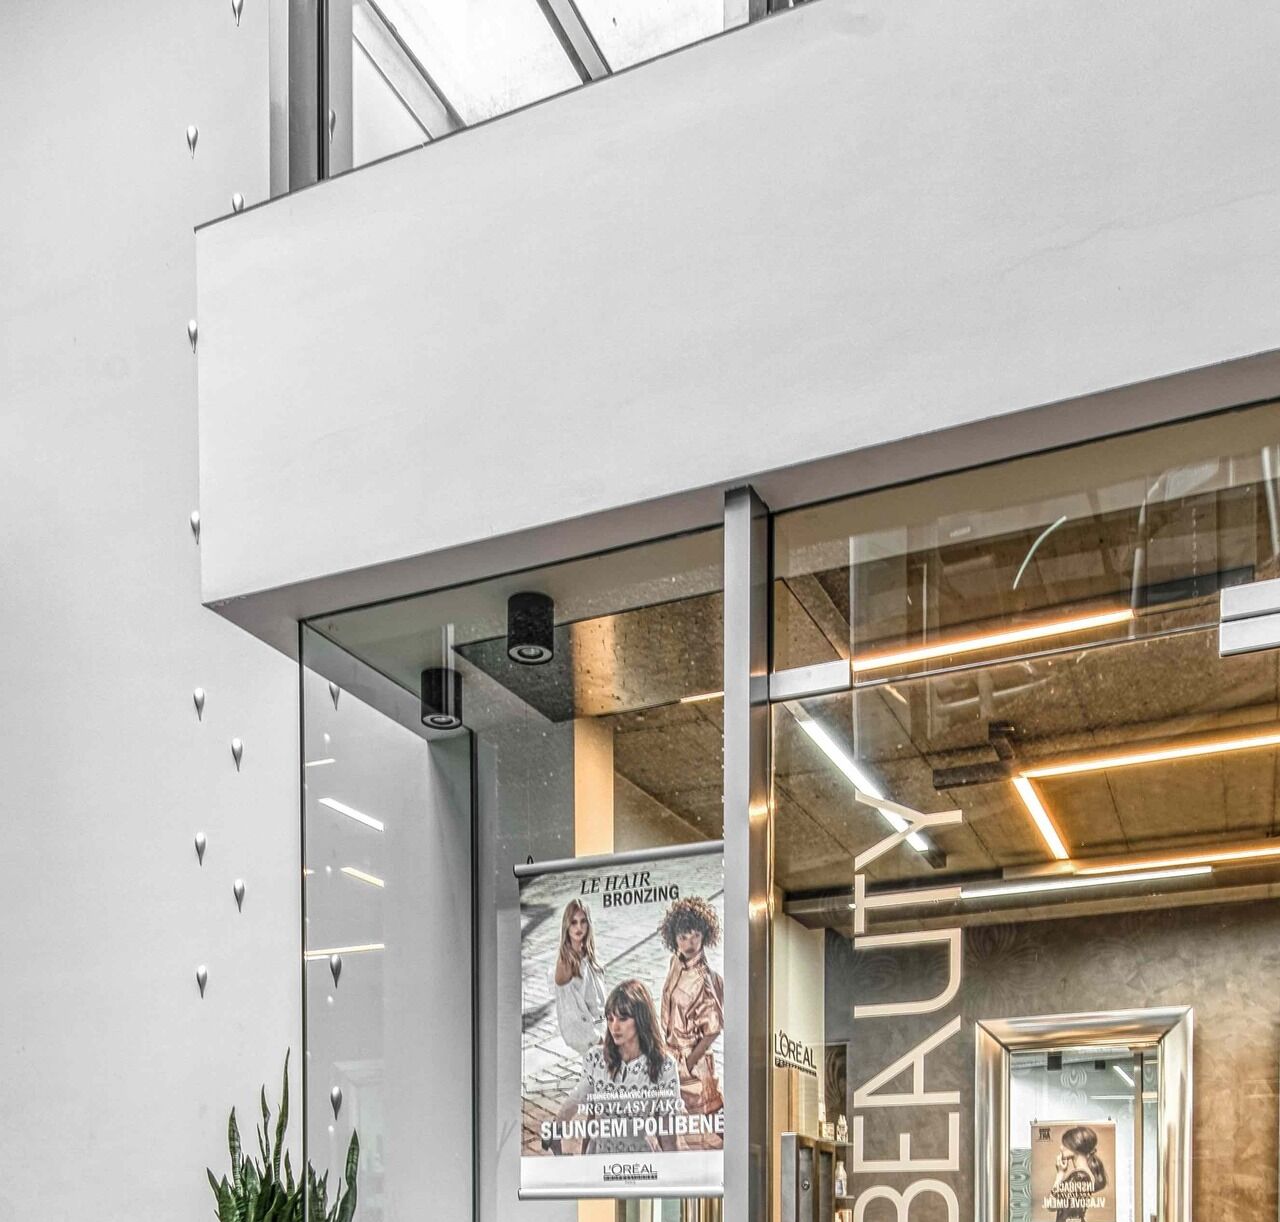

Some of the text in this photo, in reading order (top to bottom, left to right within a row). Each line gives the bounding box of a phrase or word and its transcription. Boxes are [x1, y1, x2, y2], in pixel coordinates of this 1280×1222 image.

[581, 870, 651, 896] LE HAIR
[603, 884, 679, 909] BRONZING
[774, 1028, 818, 1070] L'ORÉAL
[576, 1097, 686, 1116] PRO VLASY JAKO
[540, 1117, 628, 1141] SLUNCEM
[603, 1162, 658, 1177] L'ORÉAL
